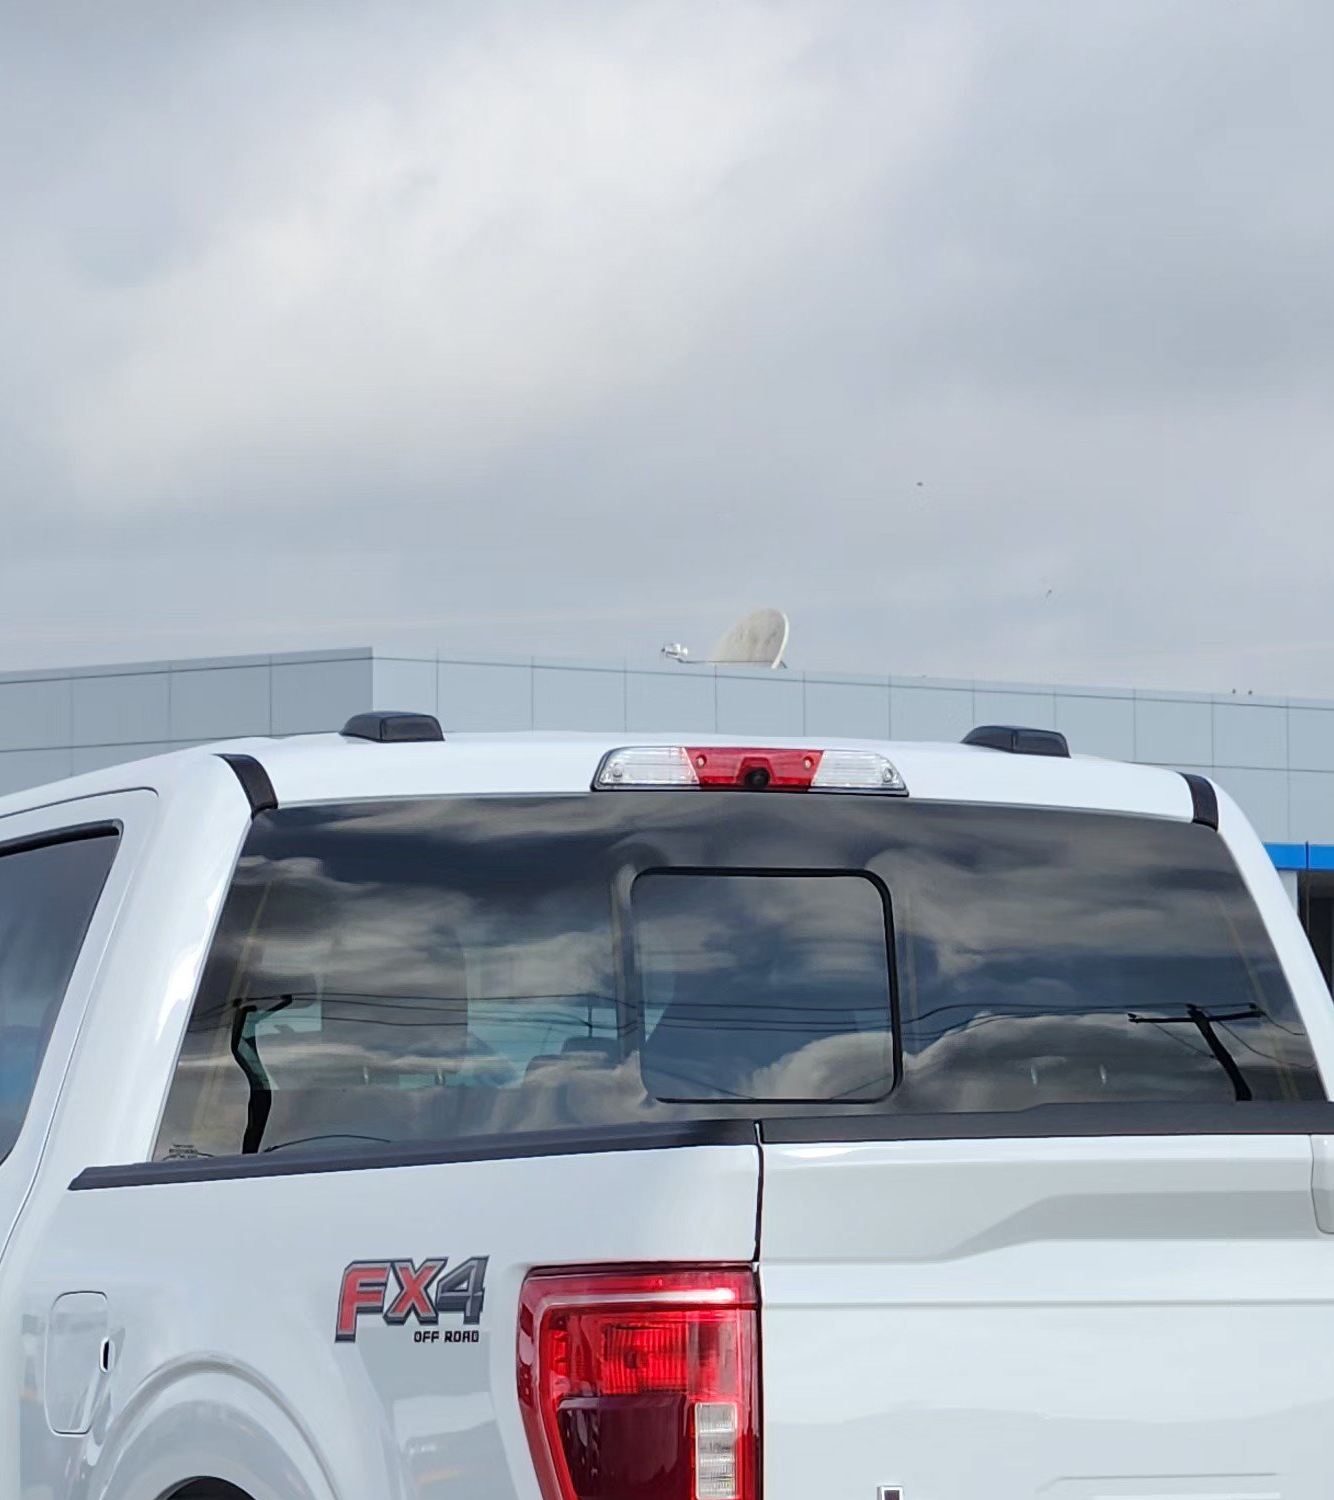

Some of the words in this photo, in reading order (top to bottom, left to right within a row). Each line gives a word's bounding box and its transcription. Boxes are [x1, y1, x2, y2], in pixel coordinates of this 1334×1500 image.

[334, 1255, 490, 1344] FX4
[413, 1330, 440, 1343] OFF
[444, 1330, 480, 1343] ROAD
